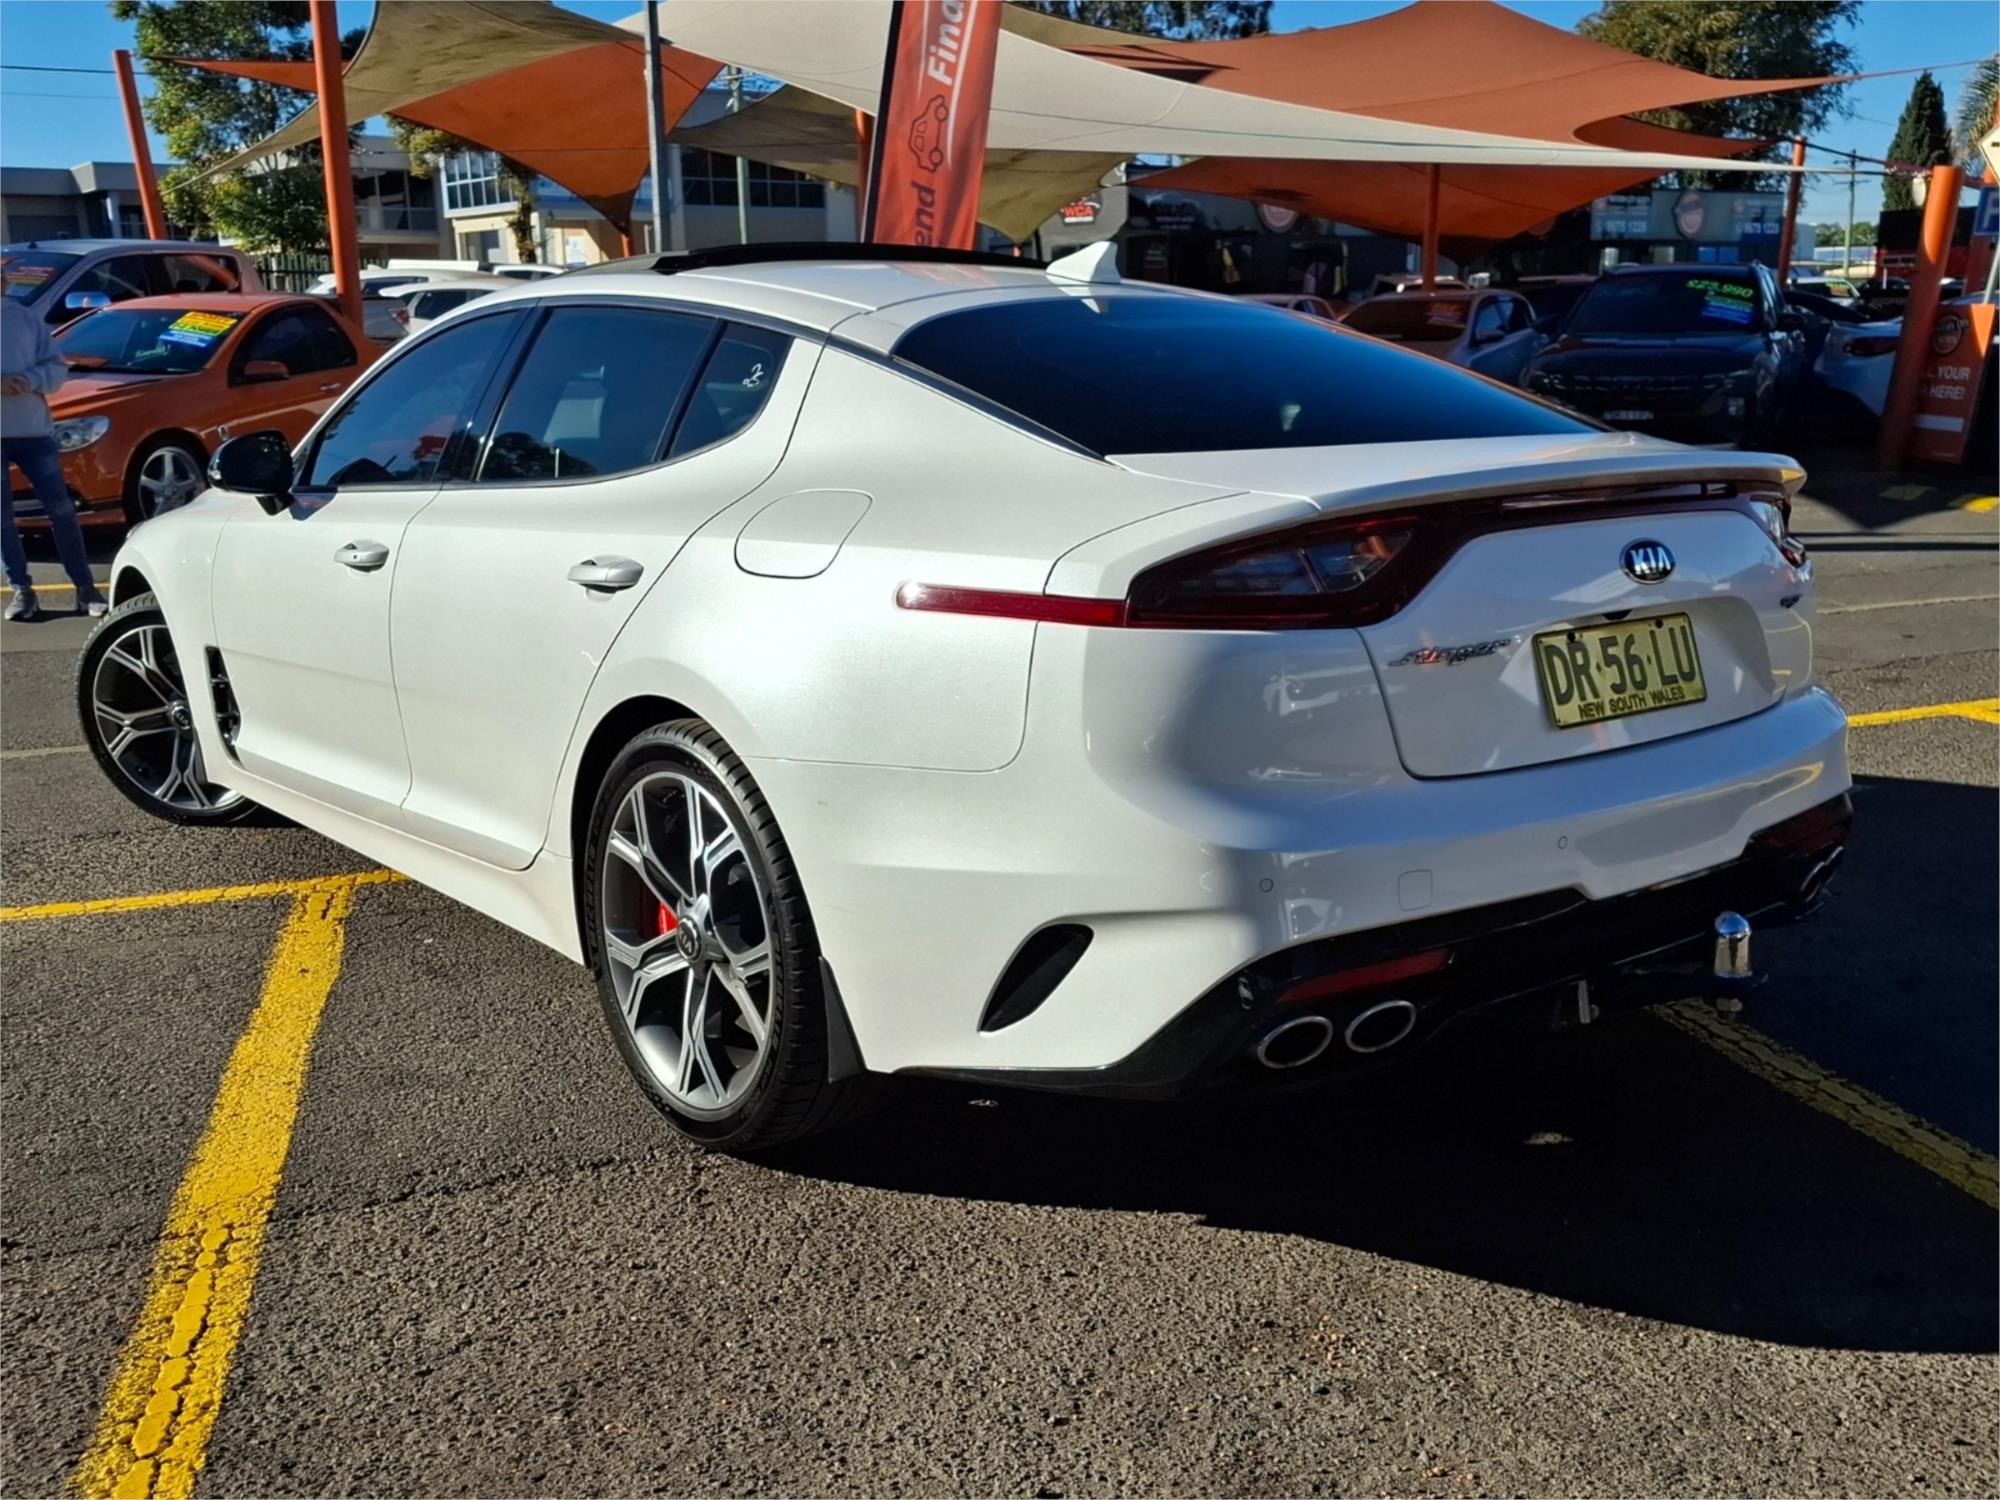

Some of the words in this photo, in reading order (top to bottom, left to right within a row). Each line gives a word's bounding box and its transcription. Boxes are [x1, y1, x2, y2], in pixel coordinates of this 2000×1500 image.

[1937, 365, 1971, 381] YOUR
[1630, 546, 1672, 576] KIA
[1578, 701, 1606, 720] NEW
[1610, 694, 1647, 713] SOUTH
[1650, 686, 1687, 707] WALES
